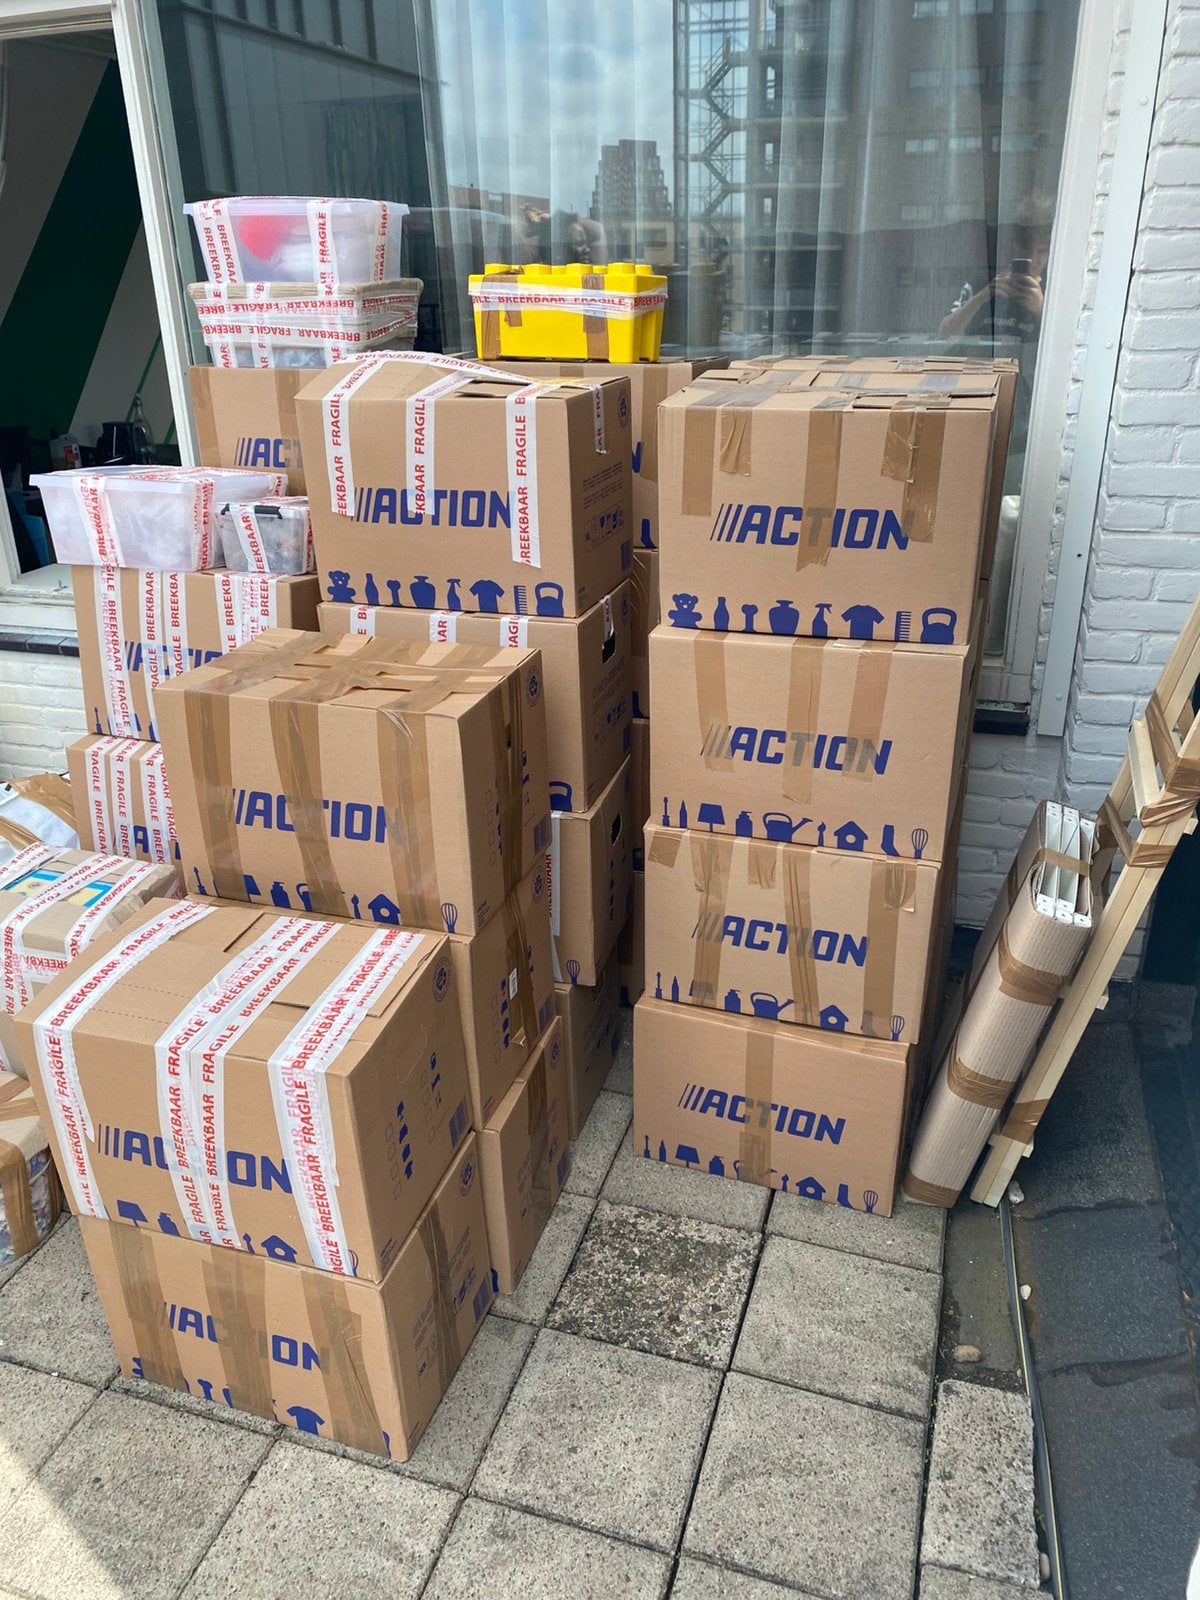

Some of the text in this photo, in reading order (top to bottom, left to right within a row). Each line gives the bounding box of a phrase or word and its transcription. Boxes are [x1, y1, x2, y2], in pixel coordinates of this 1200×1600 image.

[316, 211, 327, 263] FRAGILE
[249, 326, 291, 335] FRAGILE
[298, 328, 361, 342] BREEKBAAR
[330, 393, 343, 446] FRAGILE
[414, 397, 425, 454] FRAGILE
[515, 415, 527, 476] FRAGILE
[517, 486, 531, 565] REEKBAAR
[735, 504, 915, 550] ACTION
[145, 571, 156, 640] BREEKBAAR
[108, 600, 123, 671] BREEKBAAR
[116, 680, 131, 727] FRAGILE
[731, 726, 893, 775] ACTION
[116, 770, 126, 818] FRAGILE
[147, 774, 159, 822] FRAGILE
[3, 926, 14, 989] BREEKBAAR
[209, 955, 277, 1014] BREEKBAAR
[240, 957, 299, 1017] BREEKBAAR
[50, 960, 120, 1027] BREEKBAAR
[292, 996, 349, 1070] BREEKBAAR
[346, 951, 385, 993] FRAGILE
[48, 1037, 70, 1098] FRAGILE
[168, 1019, 208, 1076] FRAGILE
[202, 1023, 240, 1084] FRAGILE
[169, 1086, 189, 1169] BREEKBAAR
[203, 1094, 217, 1176] BREEKBAAR
[294, 1081, 317, 1145] FRAGILE
[700, 1089, 846, 1146] ACTION
[181, 1175, 206, 1224] FRAGILE
[312, 1154, 335, 1232] BREEKBAAR
